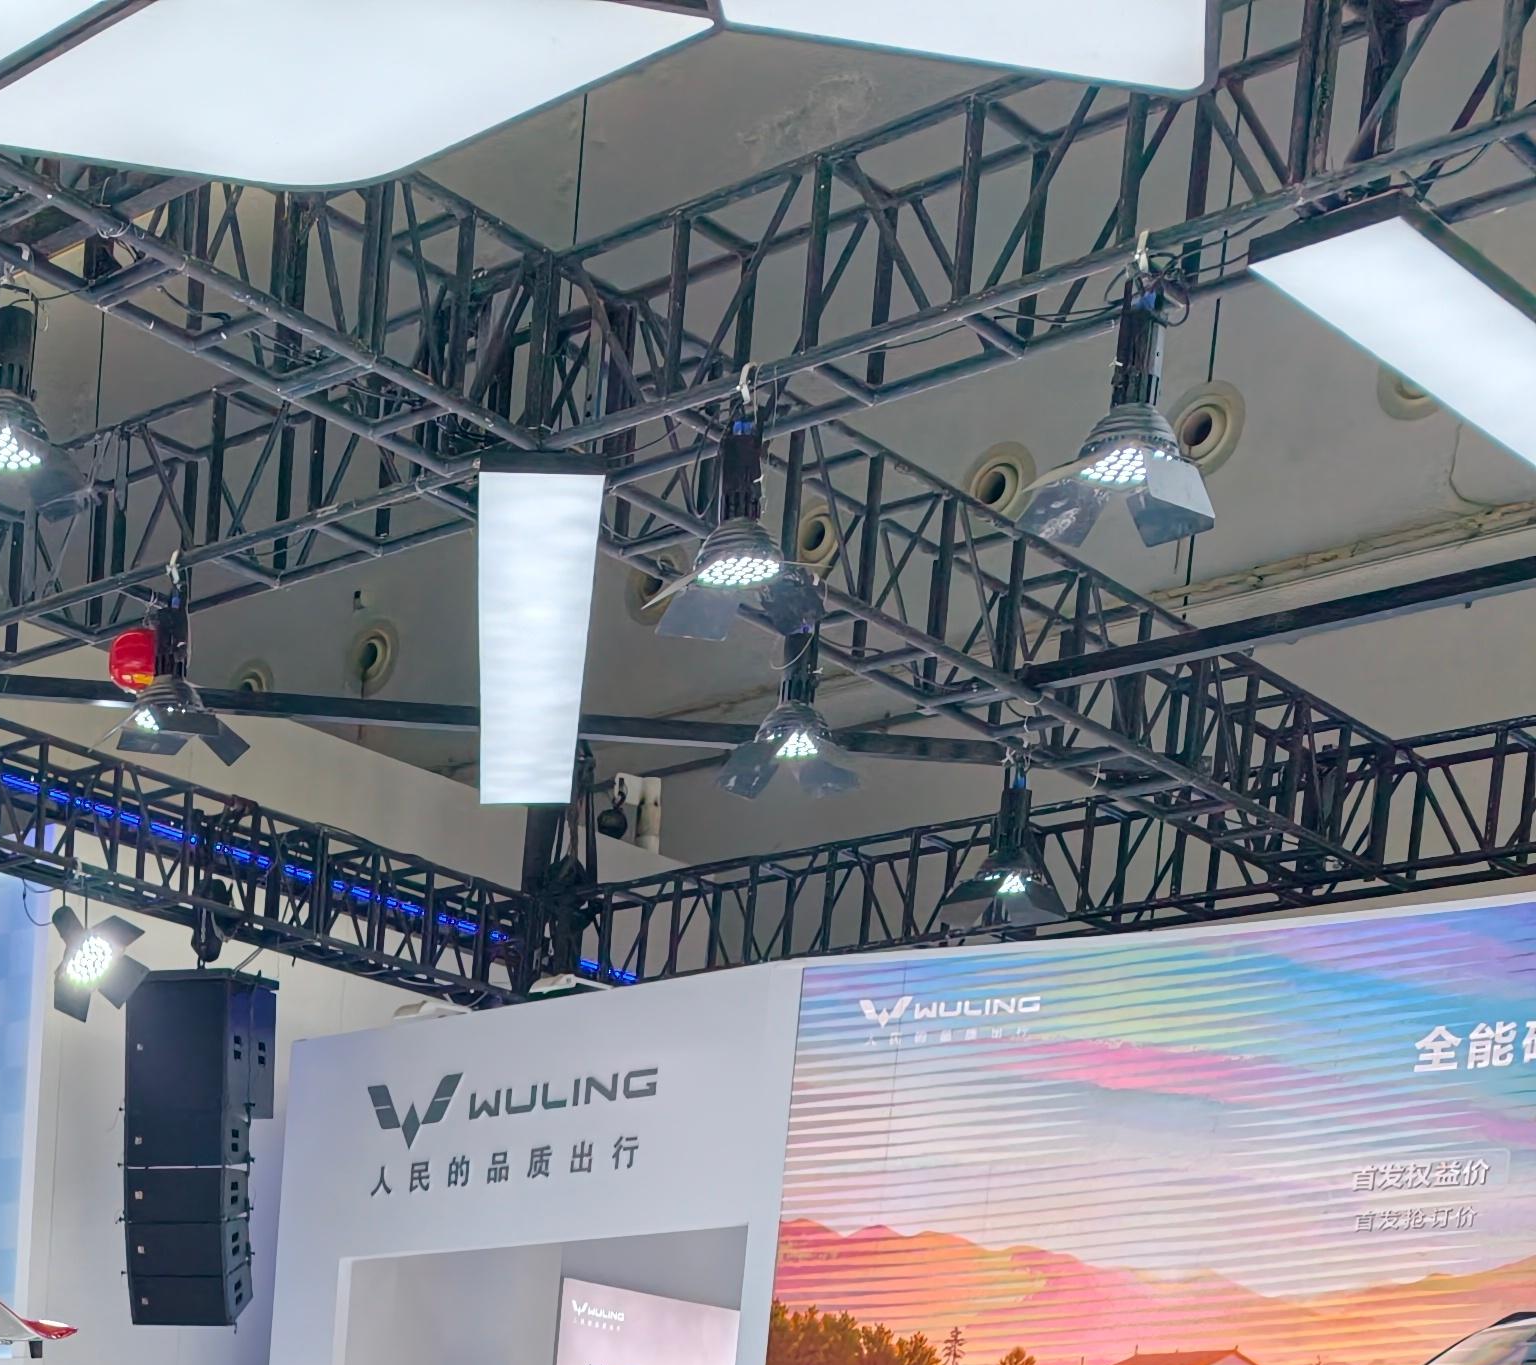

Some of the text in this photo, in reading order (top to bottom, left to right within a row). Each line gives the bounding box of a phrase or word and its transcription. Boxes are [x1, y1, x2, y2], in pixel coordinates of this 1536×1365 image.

[914, 996, 1041, 1020] WULING
[468, 1067, 659, 1121] WULING
[370, 1134, 640, 1197] 人民的品质出行
[1351, 1158, 1491, 1192] 首发权益价
